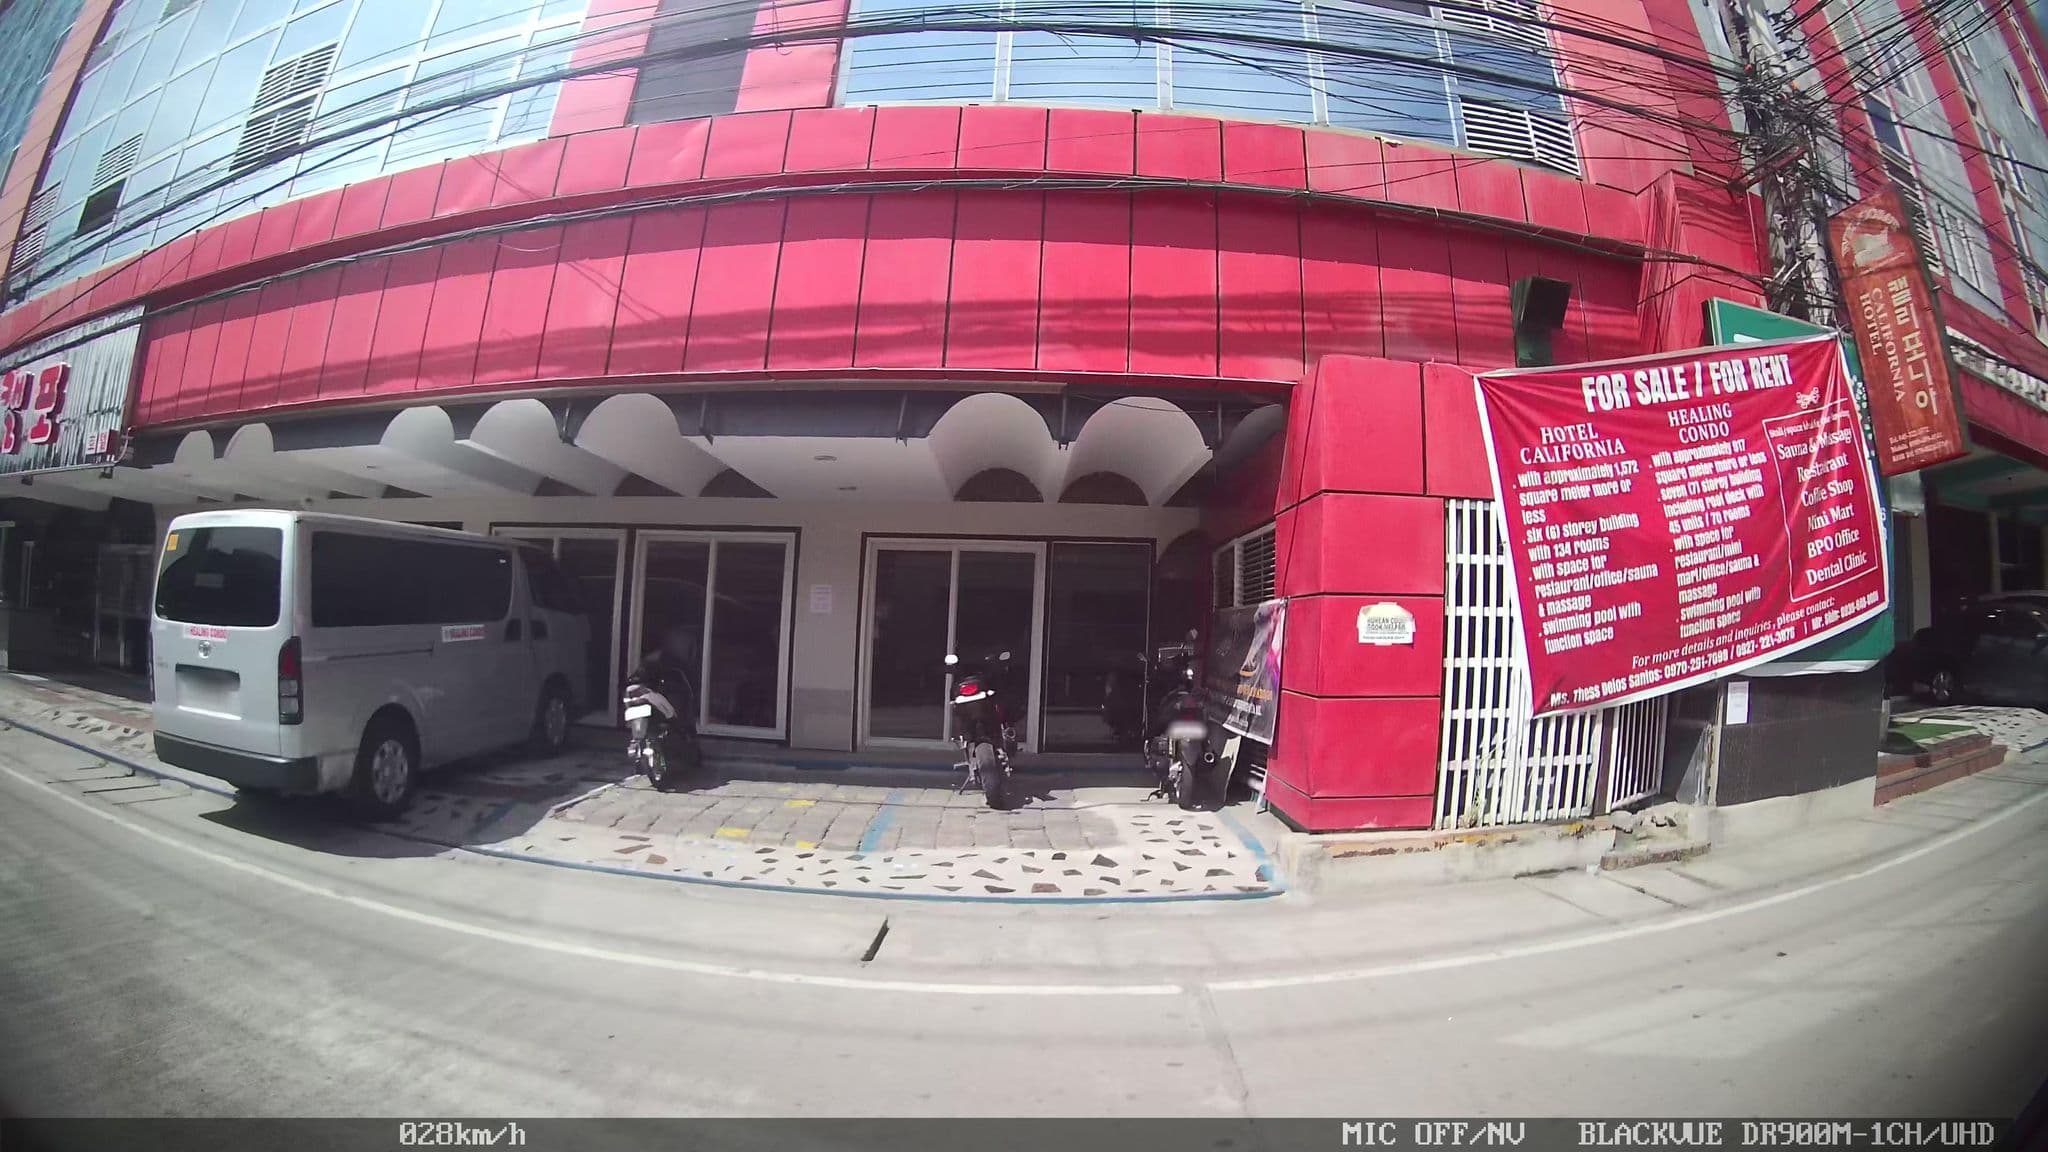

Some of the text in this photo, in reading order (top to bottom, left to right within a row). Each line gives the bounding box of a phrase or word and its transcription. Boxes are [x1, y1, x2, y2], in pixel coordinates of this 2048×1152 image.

[1859, 292, 1883, 355] HOTEL
[1871, 287, 1906, 402] CALIFORNIA
[1581, 354, 1793, 412] FOR SALE / FOR RENT
[1667, 402, 1732, 427] HEALING
[1540, 422, 1599, 444] HOTEL
[1678, 421, 1730, 444] CONDO
[1520, 438, 1626, 464] CALIFORNIA
[1651, 450, 1673, 467] with
[1776, 442, 1808, 460] Sauna
[1517, 470, 1541, 487] with
[1543, 463, 1615, 484] approximately
[1655, 467, 1687, 485] square
[1687, 462, 1714, 477] meter
[1714, 458, 1738, 473] more
[1748, 451, 1767, 465] less
[1519, 479, 1631, 506] square meter more or
[1660, 484, 1688, 500] seven
[1701, 475, 1728, 492] storey
[1746, 483, 1764, 499] with
[1827, 478, 1854, 497] Shop
[1521, 508, 1546, 525] less
[1722, 505, 1751, 522] rooms
[1829, 502, 1854, 521] Mart
[1526, 513, 1640, 543] six (6) storey building
[1673, 525, 1734, 551] with space for
[1528, 537, 1610, 562] with 134 rooms
[1807, 527, 1860, 558] BPO Office
[1532, 555, 1607, 580] with space for
[1805, 550, 1867, 585] Dental Clinic
[1546, 594, 1592, 616] massage
[1678, 582, 1717, 604] massage
[1680, 586, 1761, 622] swimming pool with
[1542, 601, 1642, 636] swimming pool with
[1680, 610, 1741, 639] function space
[1544, 626, 1614, 655] function space
[1632, 655, 1650, 669] For
[1652, 648, 1680, 665] more
[1681, 636, 1715, 656] details
[1715, 629, 1733, 646] and
[1776, 610, 1805, 630] please
[1550, 691, 1570, 707] Ms.
[1573, 684, 1600, 703] Thess
[1601, 678, 1627, 697] Delos
